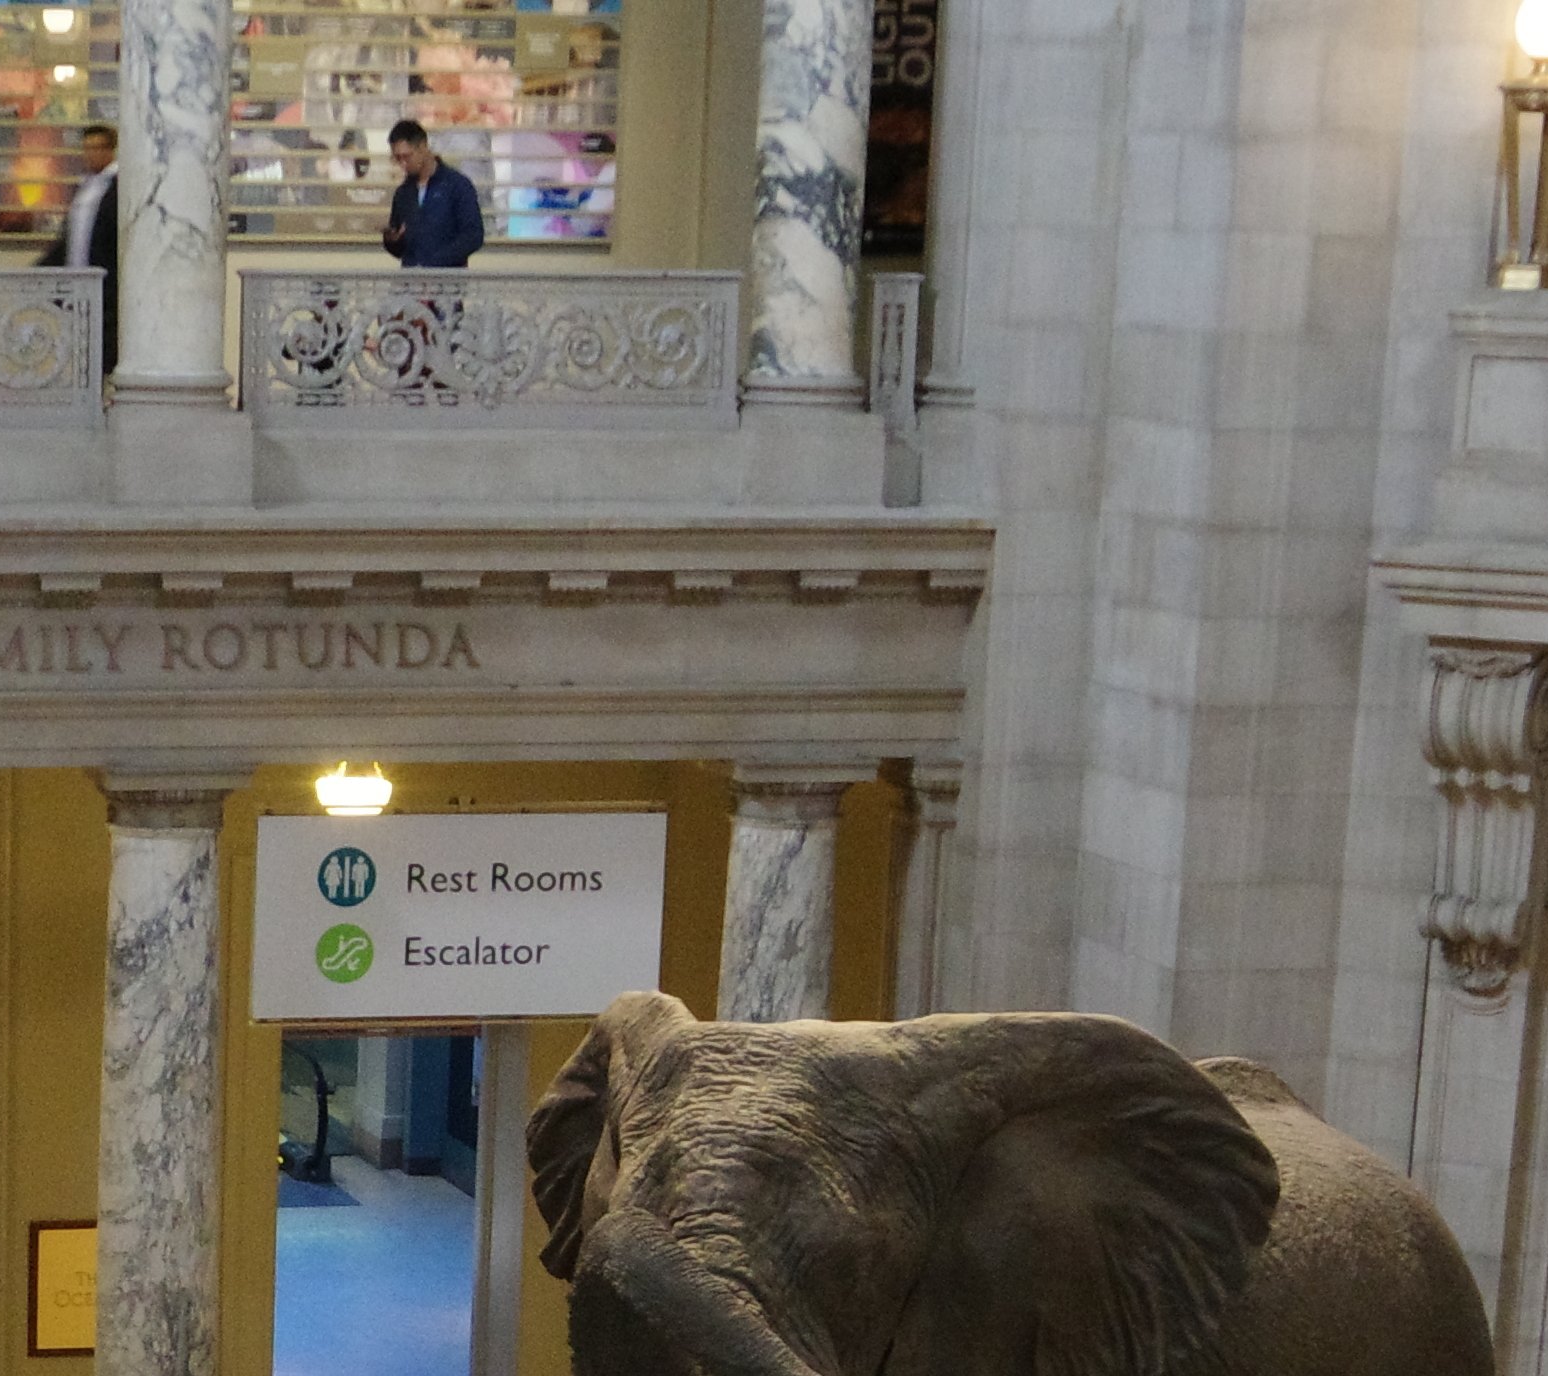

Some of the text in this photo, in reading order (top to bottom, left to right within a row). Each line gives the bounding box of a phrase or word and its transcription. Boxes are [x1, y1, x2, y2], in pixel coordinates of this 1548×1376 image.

[160, 621, 479, 673] ROTUNDA
[407, 863, 603, 893] Rest Rooms
[404, 936, 550, 966] Escalator
